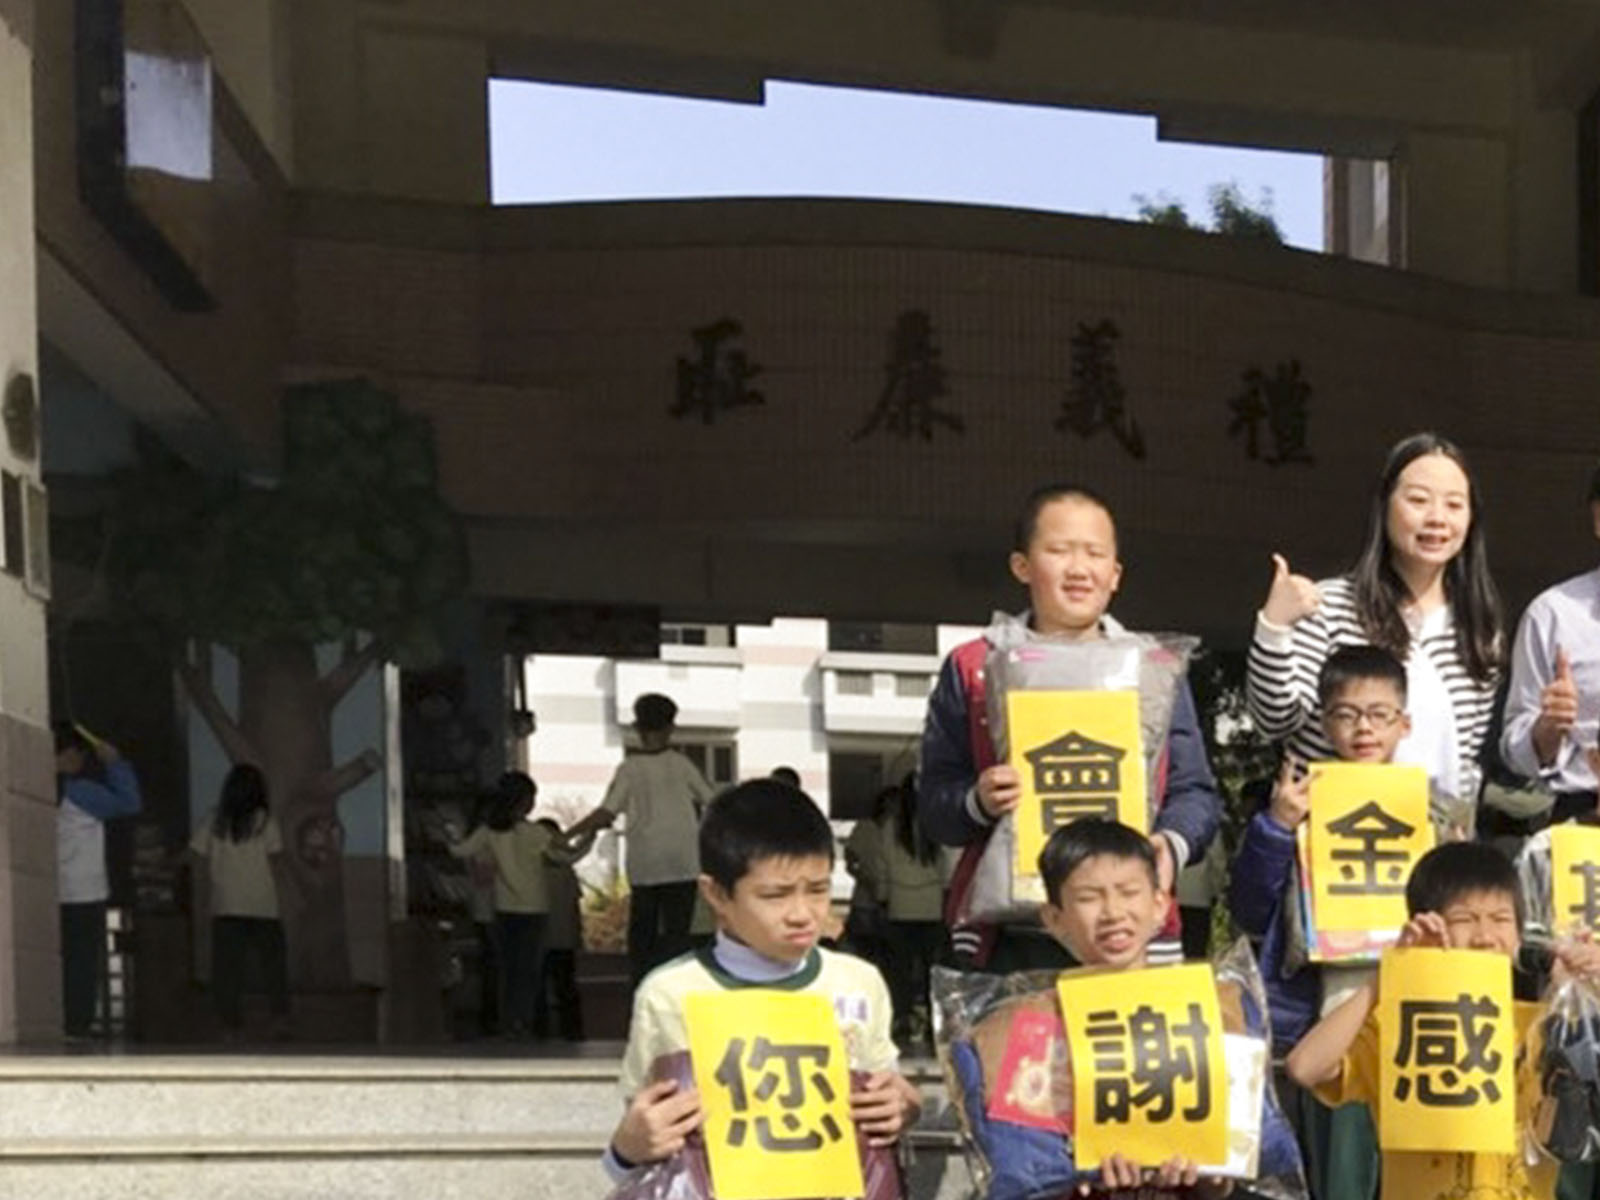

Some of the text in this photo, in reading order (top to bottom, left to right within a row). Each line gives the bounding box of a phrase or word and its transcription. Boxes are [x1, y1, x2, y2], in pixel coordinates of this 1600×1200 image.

[1024, 730, 1127, 834] 會
[1326, 800, 1416, 896] 金
[714, 1036, 843, 1153] 您
[1084, 1002, 1211, 1124] 謝
[1394, 993, 1503, 1108] 感
